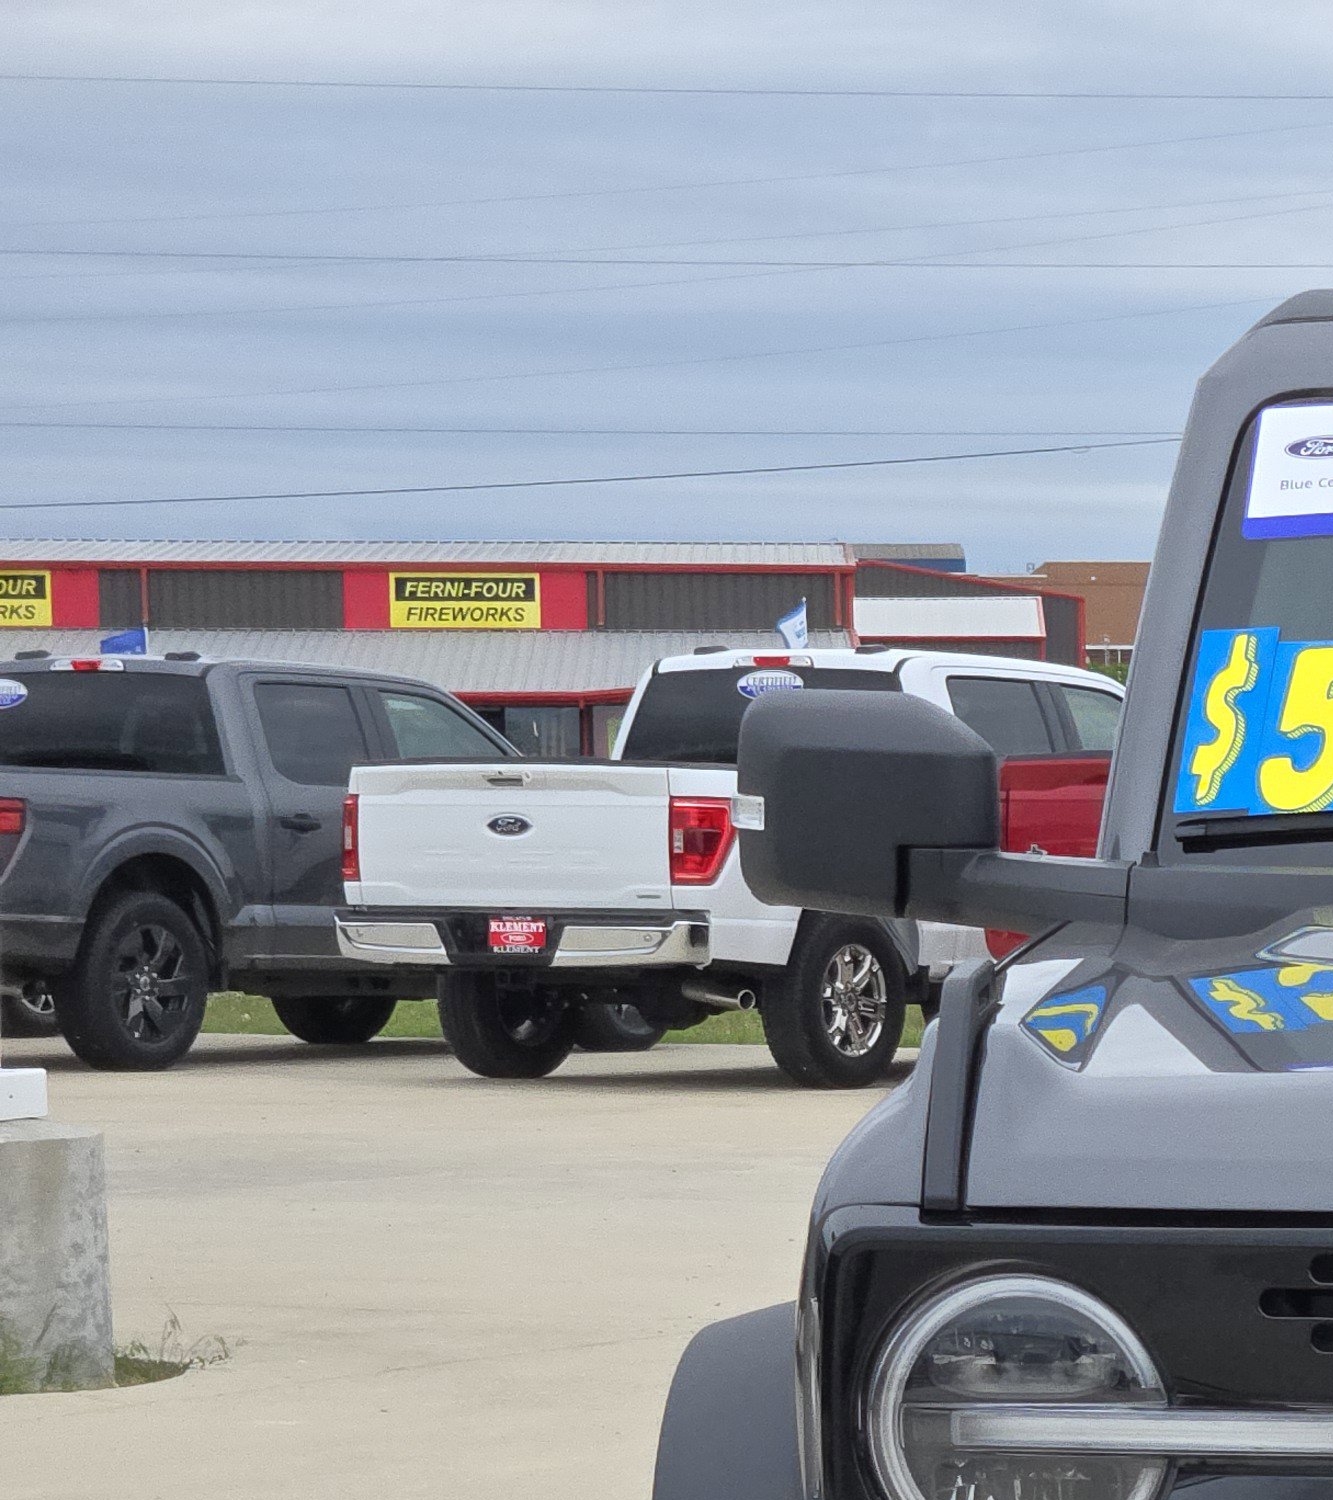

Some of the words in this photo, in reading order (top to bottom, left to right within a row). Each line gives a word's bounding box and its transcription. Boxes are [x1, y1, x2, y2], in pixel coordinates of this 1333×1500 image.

[1280, 479, 1313, 490] Blue
[405, 581, 526, 598] FERNI-FOUR
[406, 607, 525, 622] FIREWORKS
[490, 921, 546, 932] KLEMENT
